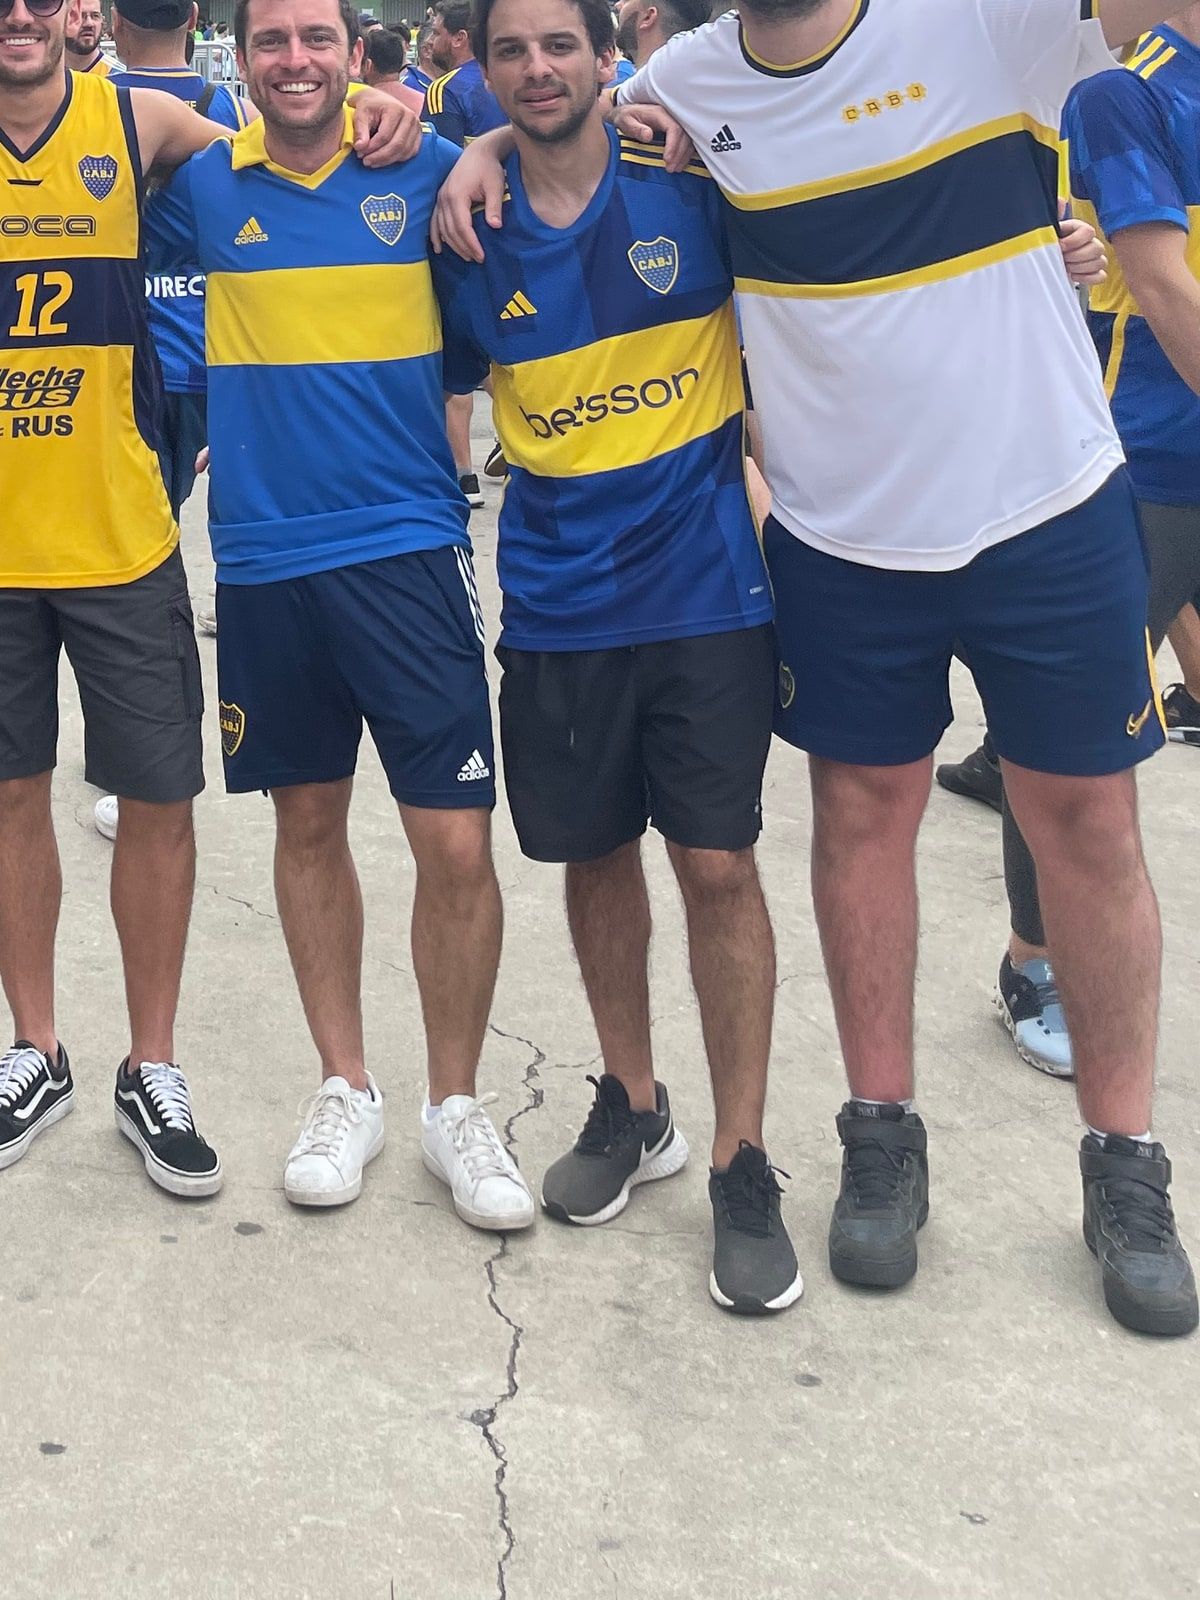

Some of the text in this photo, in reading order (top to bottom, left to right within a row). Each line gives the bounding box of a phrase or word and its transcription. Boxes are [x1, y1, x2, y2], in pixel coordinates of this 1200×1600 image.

[845, 85, 922, 122] CABJ
[711, 140, 742, 153] adidas
[83, 168, 115, 179] CABJ
[369, 210, 402, 223] CABJ
[234, 232, 269, 246] adidas
[638, 256, 673, 271] CABJ
[144, 275, 208, 299] IREC
[8, 270, 73, 337] 12
[519, 368, 699, 439] betsson
[12, 414, 74, 438] RUS
[456, 767, 490, 782] adidas
